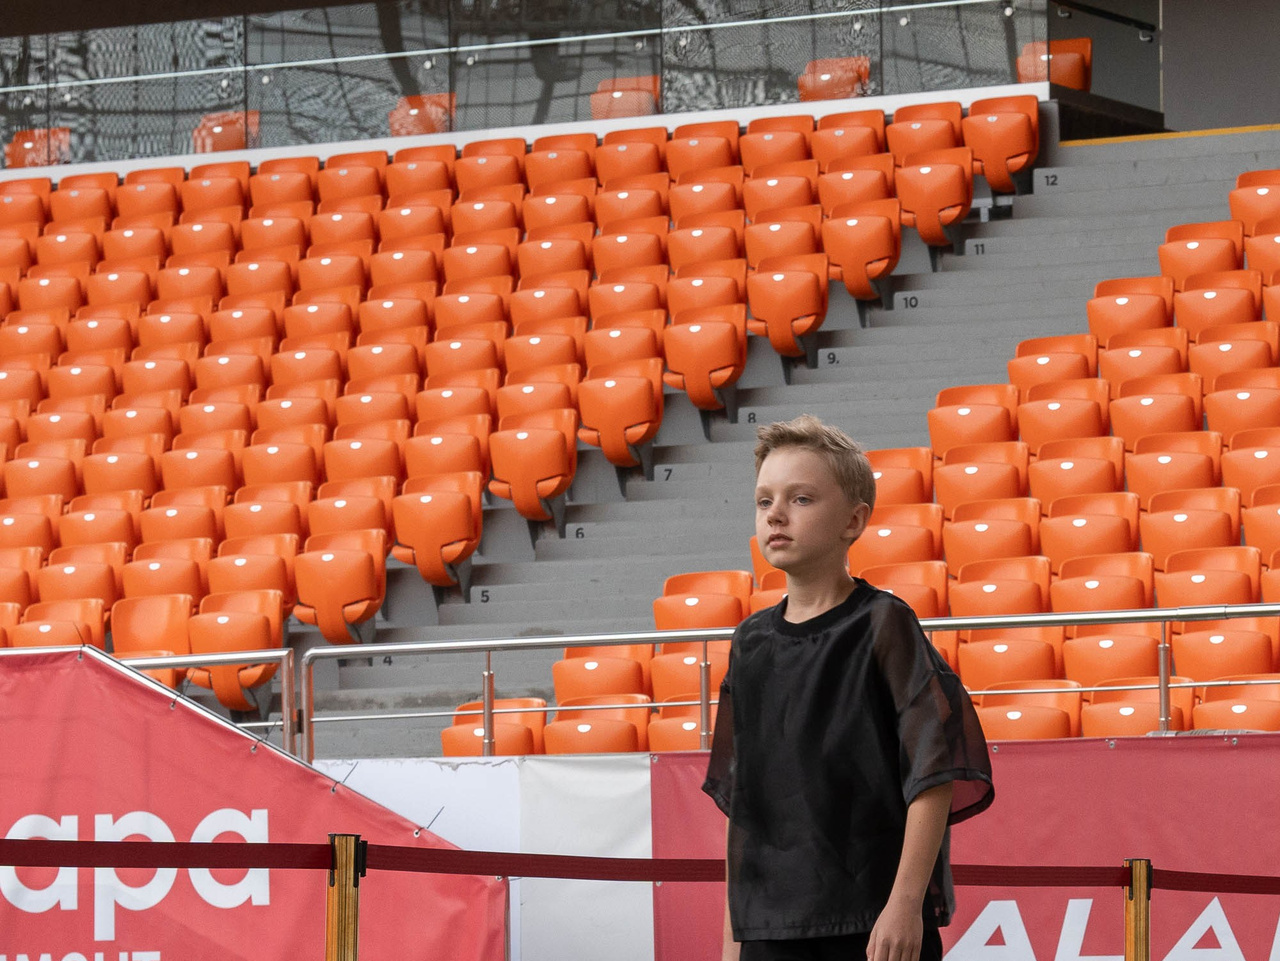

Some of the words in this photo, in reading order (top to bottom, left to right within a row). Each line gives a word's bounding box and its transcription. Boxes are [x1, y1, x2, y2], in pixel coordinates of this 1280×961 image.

[1044, 174, 1058, 186] 12
[974, 243, 985, 255] 11
[903, 296, 918, 309] 10
[748, 412, 757, 424] 8
[664, 469, 673, 481] 7
[575, 527, 585, 539] 6
[480, 590, 490, 603] 5
[382, 655, 393, 666] 4
